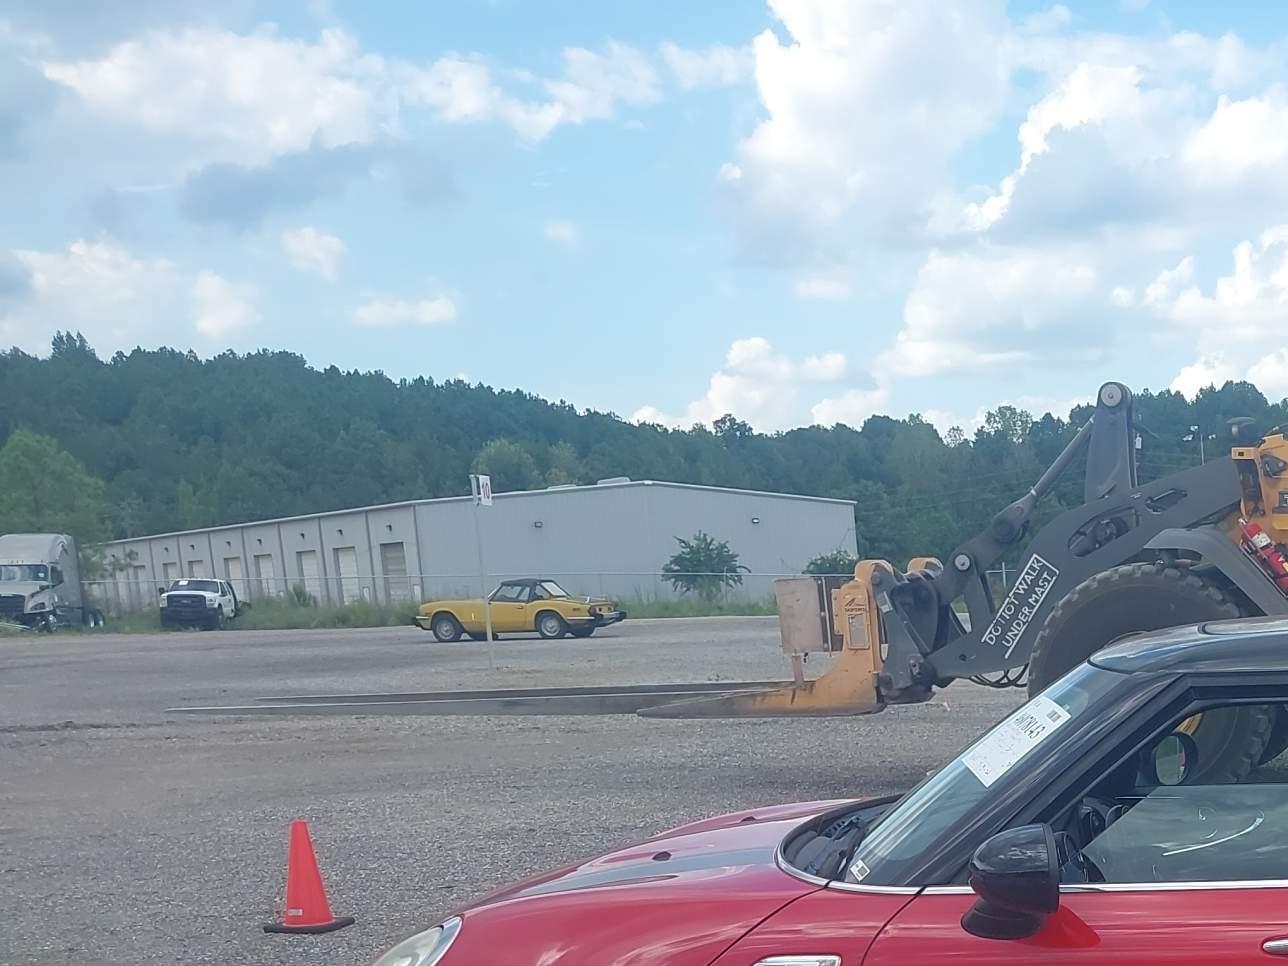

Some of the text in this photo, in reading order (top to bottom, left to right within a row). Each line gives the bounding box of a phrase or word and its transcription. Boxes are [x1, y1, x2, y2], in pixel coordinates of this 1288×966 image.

[1015, 557, 1044, 595] WALK
[1001, 571, 1054, 647] UNDER MAST
